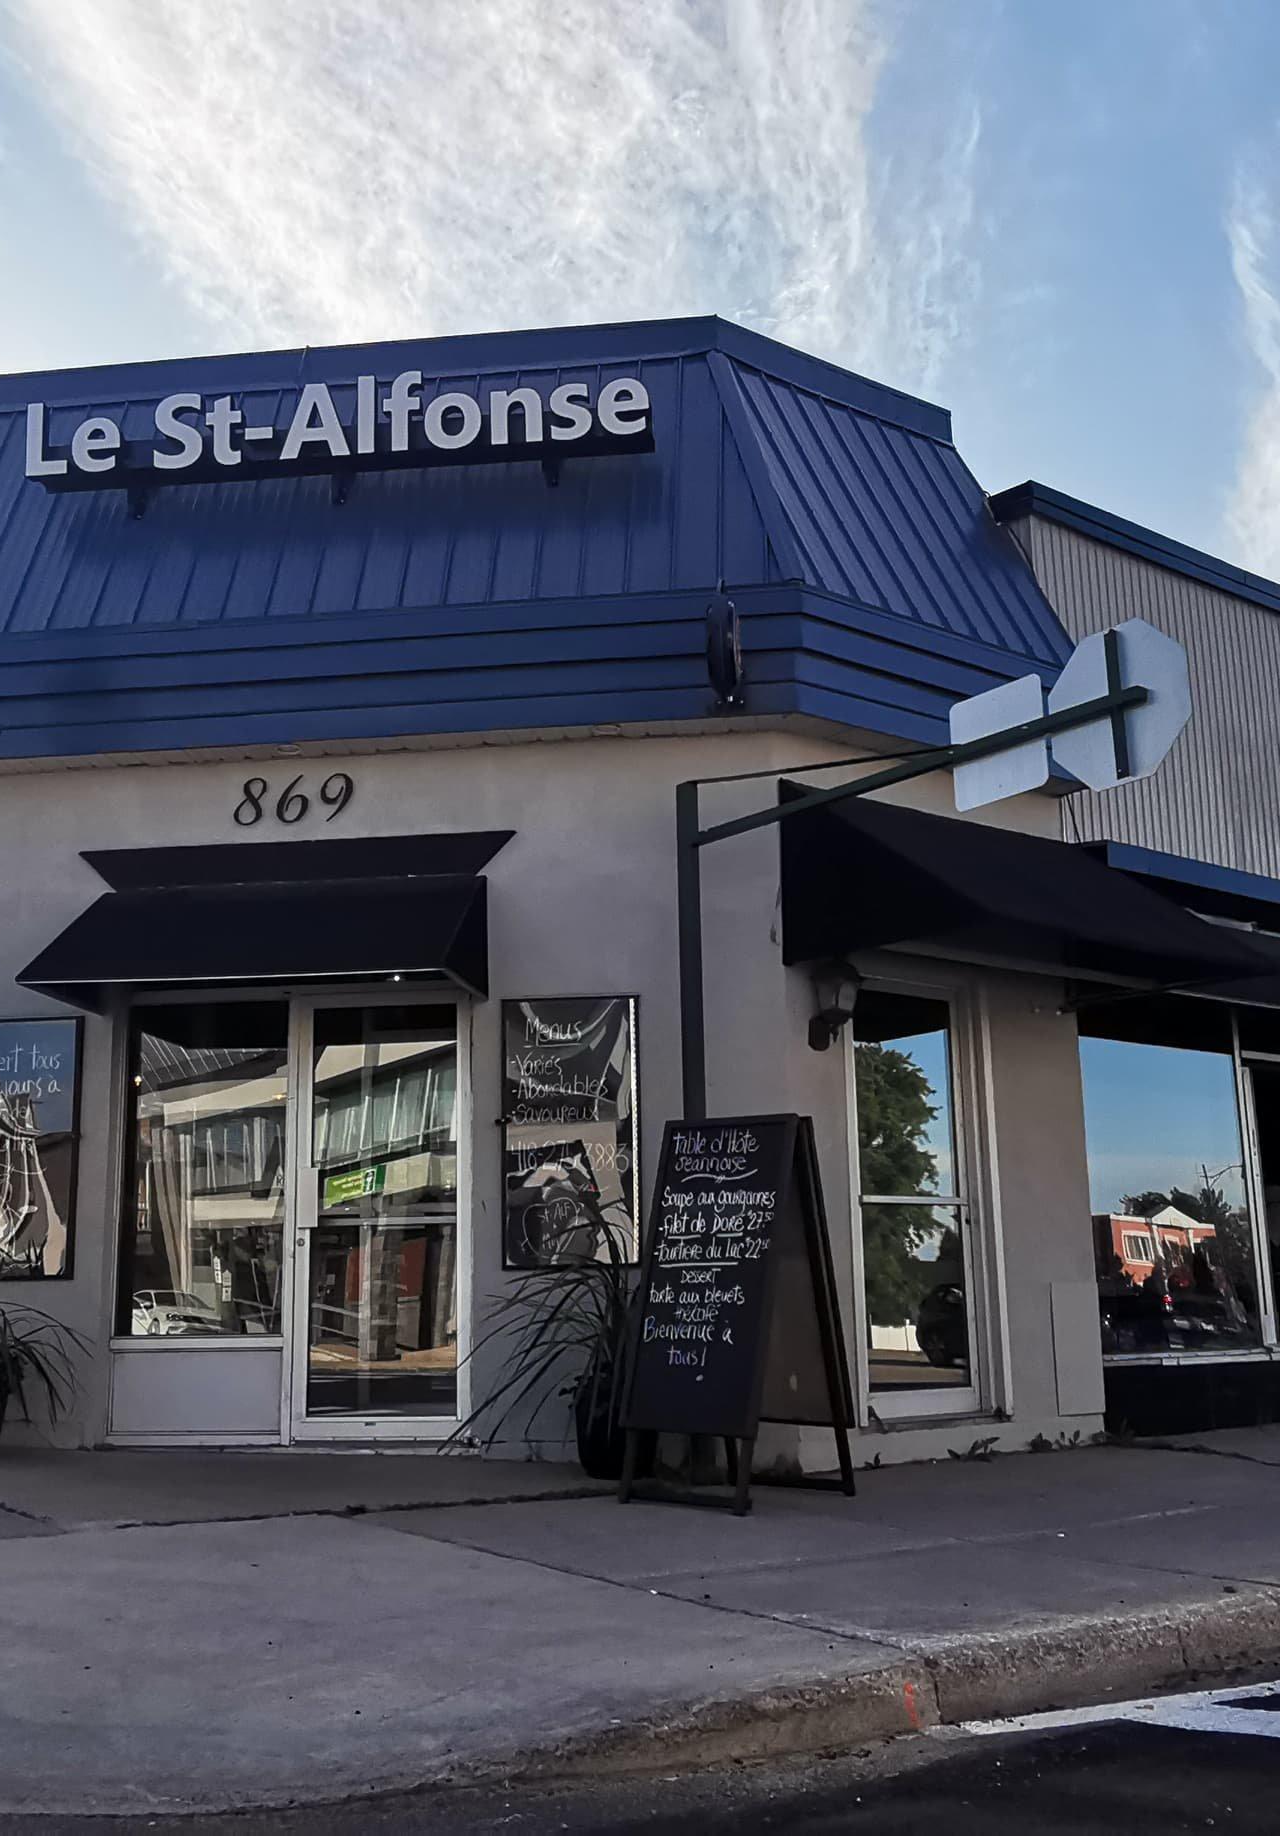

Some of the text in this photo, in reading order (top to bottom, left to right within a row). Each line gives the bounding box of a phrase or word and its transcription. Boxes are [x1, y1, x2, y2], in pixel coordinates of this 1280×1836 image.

[25, 370, 650, 477] Le St-Alfonse
[232, 772, 354, 827] 869
[48, 1074, 61, 1093] à
[691, 1211, 706, 1232] de
[706, 1236, 722, 1259] du
[643, 1315, 715, 1343] Bienvenue
